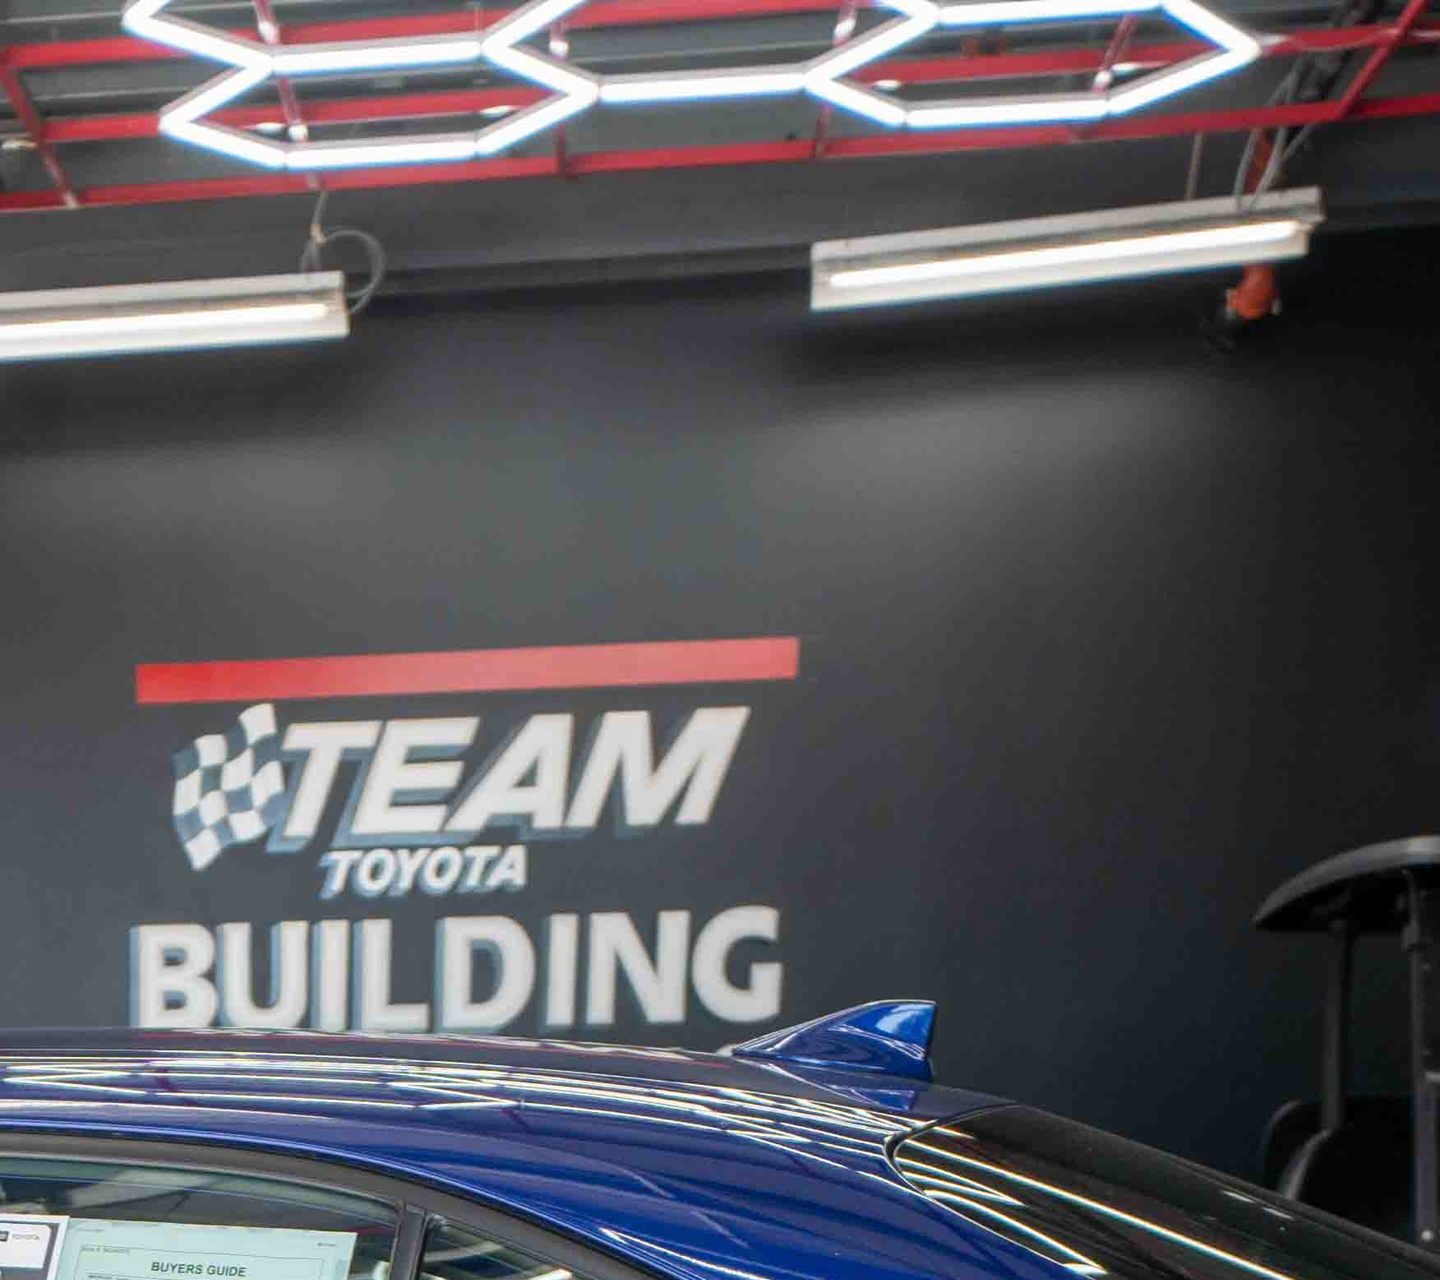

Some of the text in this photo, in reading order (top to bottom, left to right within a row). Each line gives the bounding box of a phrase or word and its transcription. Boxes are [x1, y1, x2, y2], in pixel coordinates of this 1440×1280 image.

[270, 704, 752, 850] TEAM
[320, 842, 528, 898] TOYOTA
[130, 904, 784, 1032] BUILDING
[150, 1261, 247, 1278] BUYERS GUIDE
